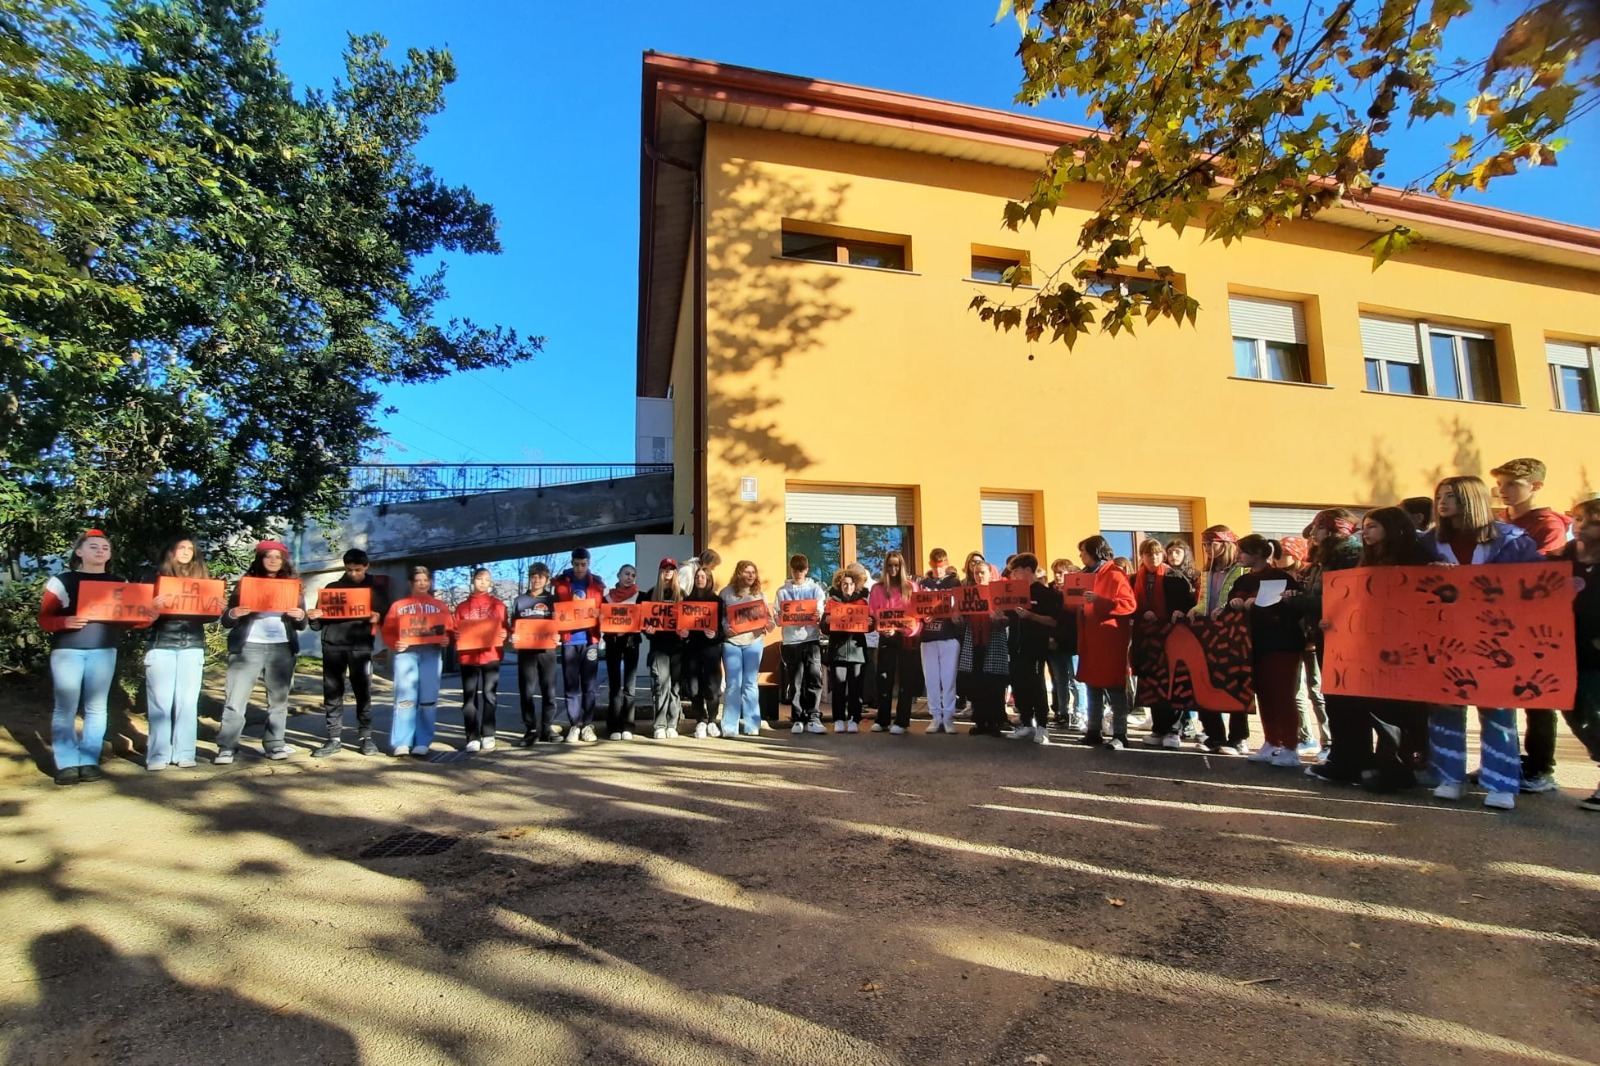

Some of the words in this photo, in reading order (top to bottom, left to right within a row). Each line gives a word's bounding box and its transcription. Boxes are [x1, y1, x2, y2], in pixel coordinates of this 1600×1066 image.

[181, 582, 200, 594] LA
[963, 587, 981, 600] HA
[321, 592, 347, 604] CHE
[350, 604, 366, 616] HA
[398, 604, 417, 616] NEW
[651, 604, 674, 617] CHE
[783, 603, 791, 612] E
[836, 607, 864, 615] NON
[958, 599, 989, 612] UCCISO
[643, 617, 665, 629] NON
